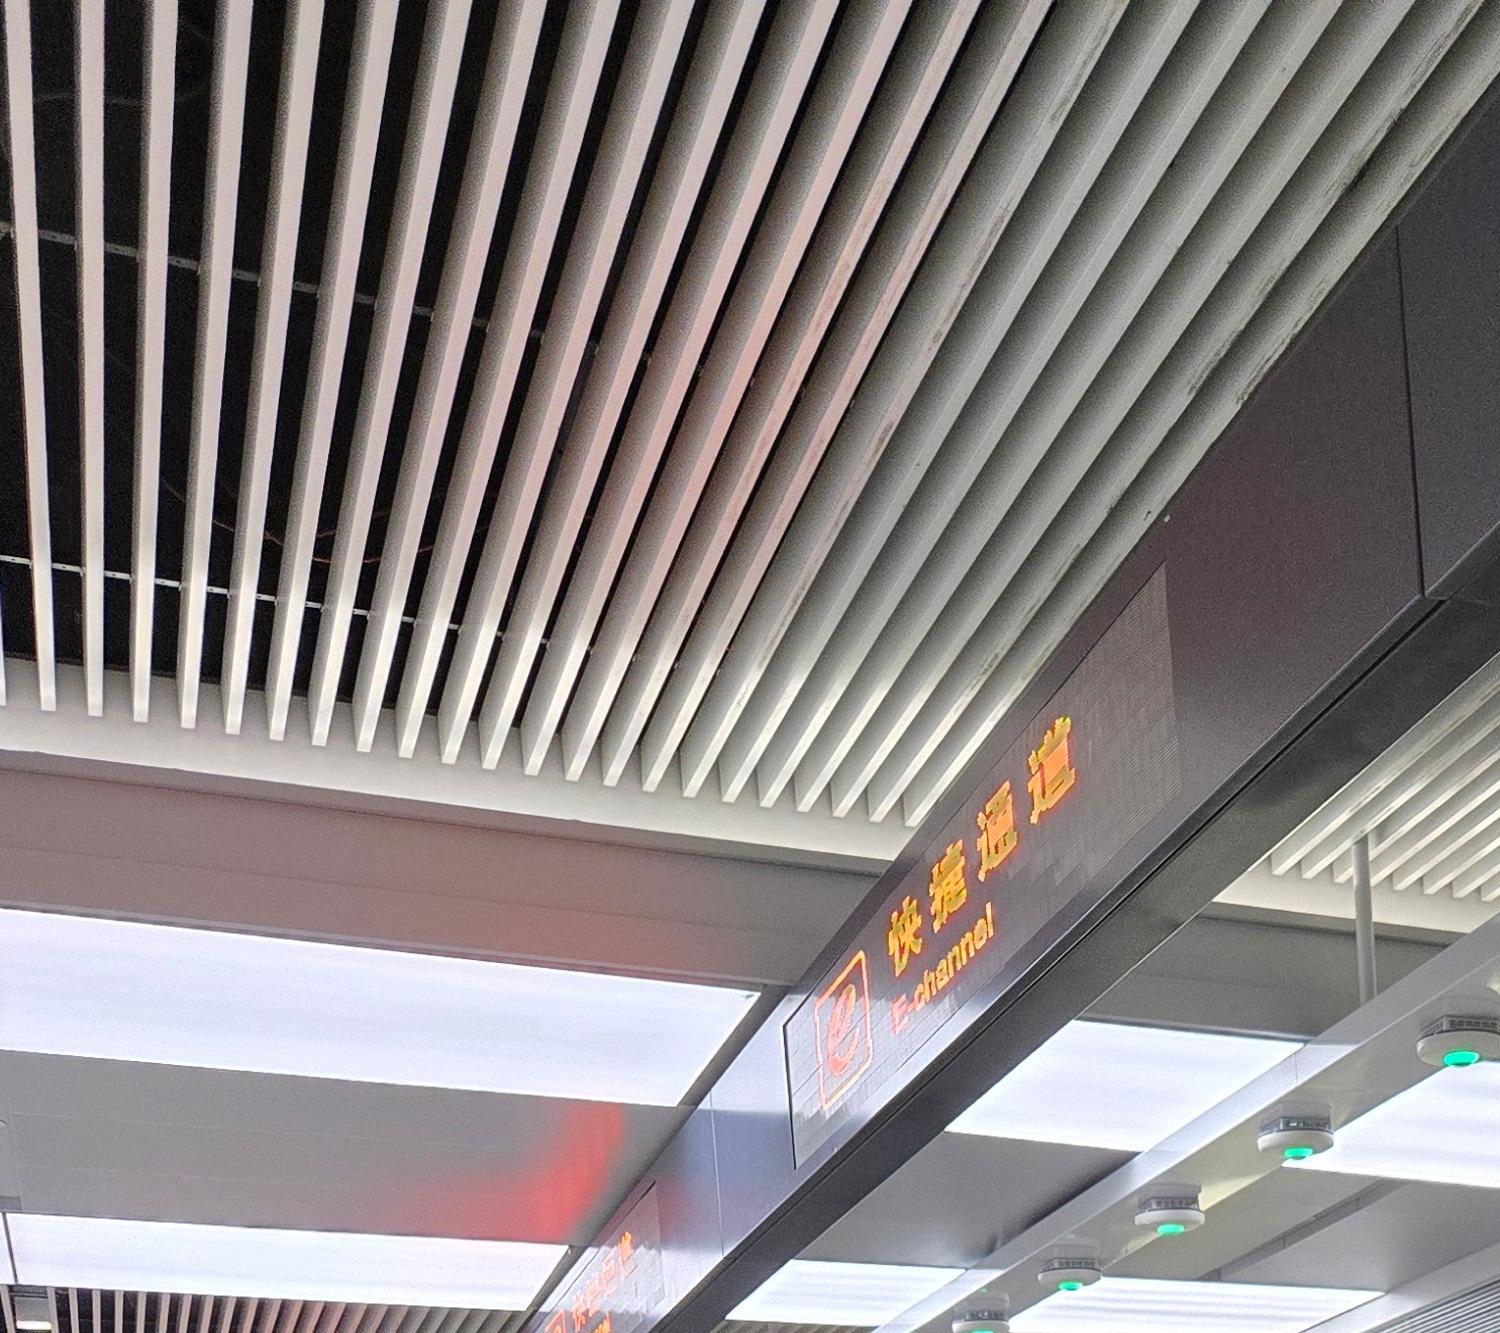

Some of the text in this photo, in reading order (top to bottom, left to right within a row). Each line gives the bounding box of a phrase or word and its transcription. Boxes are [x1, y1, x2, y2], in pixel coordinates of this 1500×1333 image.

[888, 716, 1075, 977] 快捷通道
[889, 902, 995, 1034] E-channel
